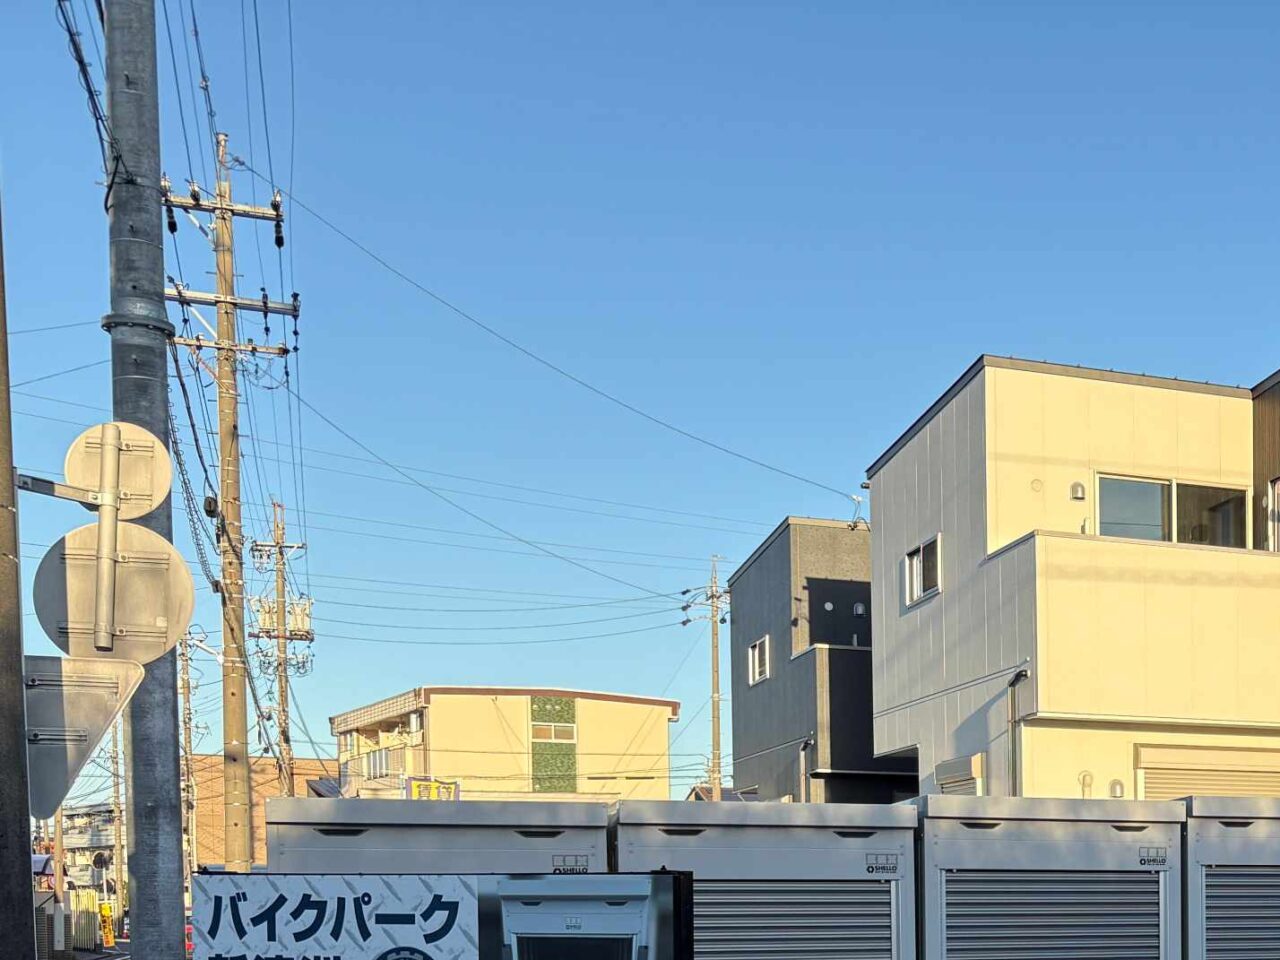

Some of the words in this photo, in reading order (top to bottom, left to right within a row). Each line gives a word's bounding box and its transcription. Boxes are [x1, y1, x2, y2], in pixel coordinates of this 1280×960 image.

[207, 891, 459, 944] バイクパーク
